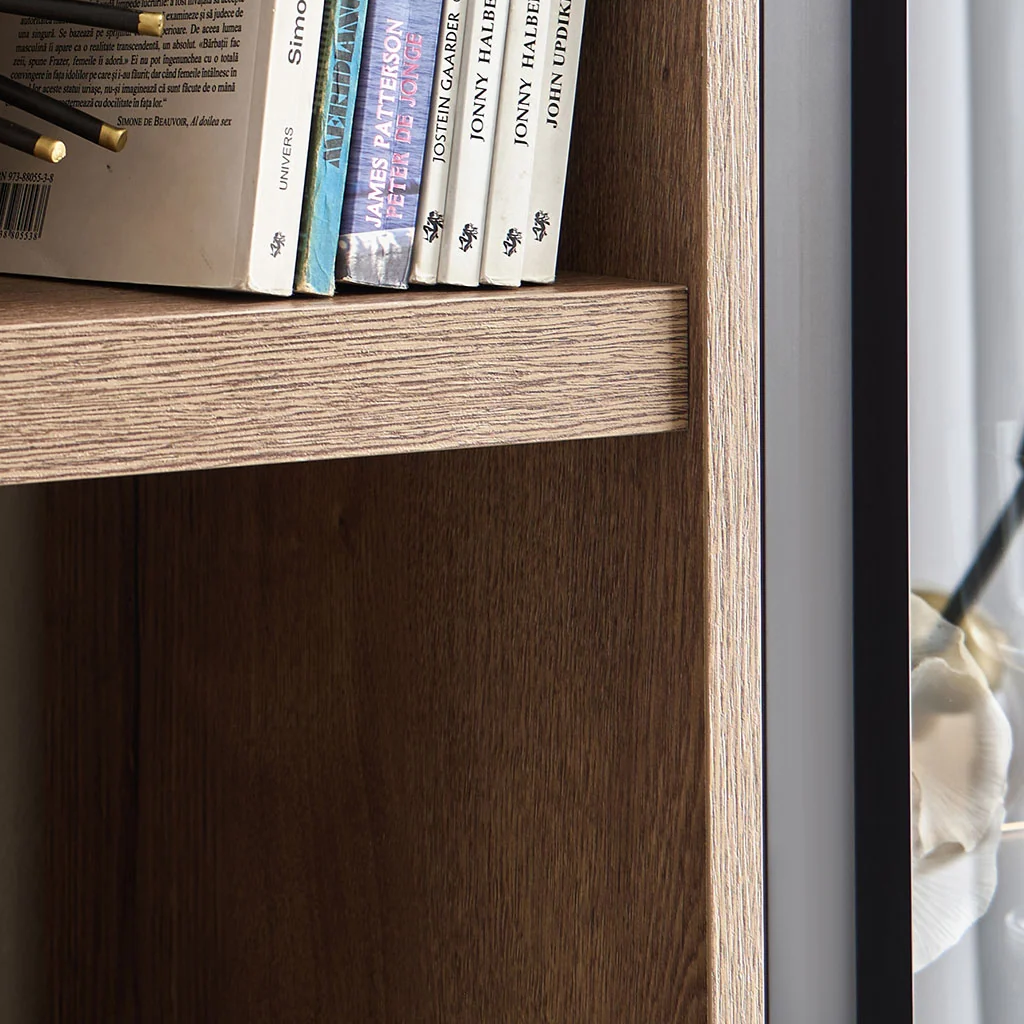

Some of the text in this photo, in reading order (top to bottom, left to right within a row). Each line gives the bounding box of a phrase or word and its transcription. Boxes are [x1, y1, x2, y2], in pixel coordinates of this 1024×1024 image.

[433, 12, 460, 163] JOSTEIN GAARDER
[470, 73, 489, 142] JONNY
[514, 77, 532, 147] JONNY
[546, 72, 564, 128] JOHN
[366, 19, 405, 228] JAMES PATTERSON
[386, 32, 423, 219] PETER DE JONGE
[278, 127, 294, 191] UNIVERS
